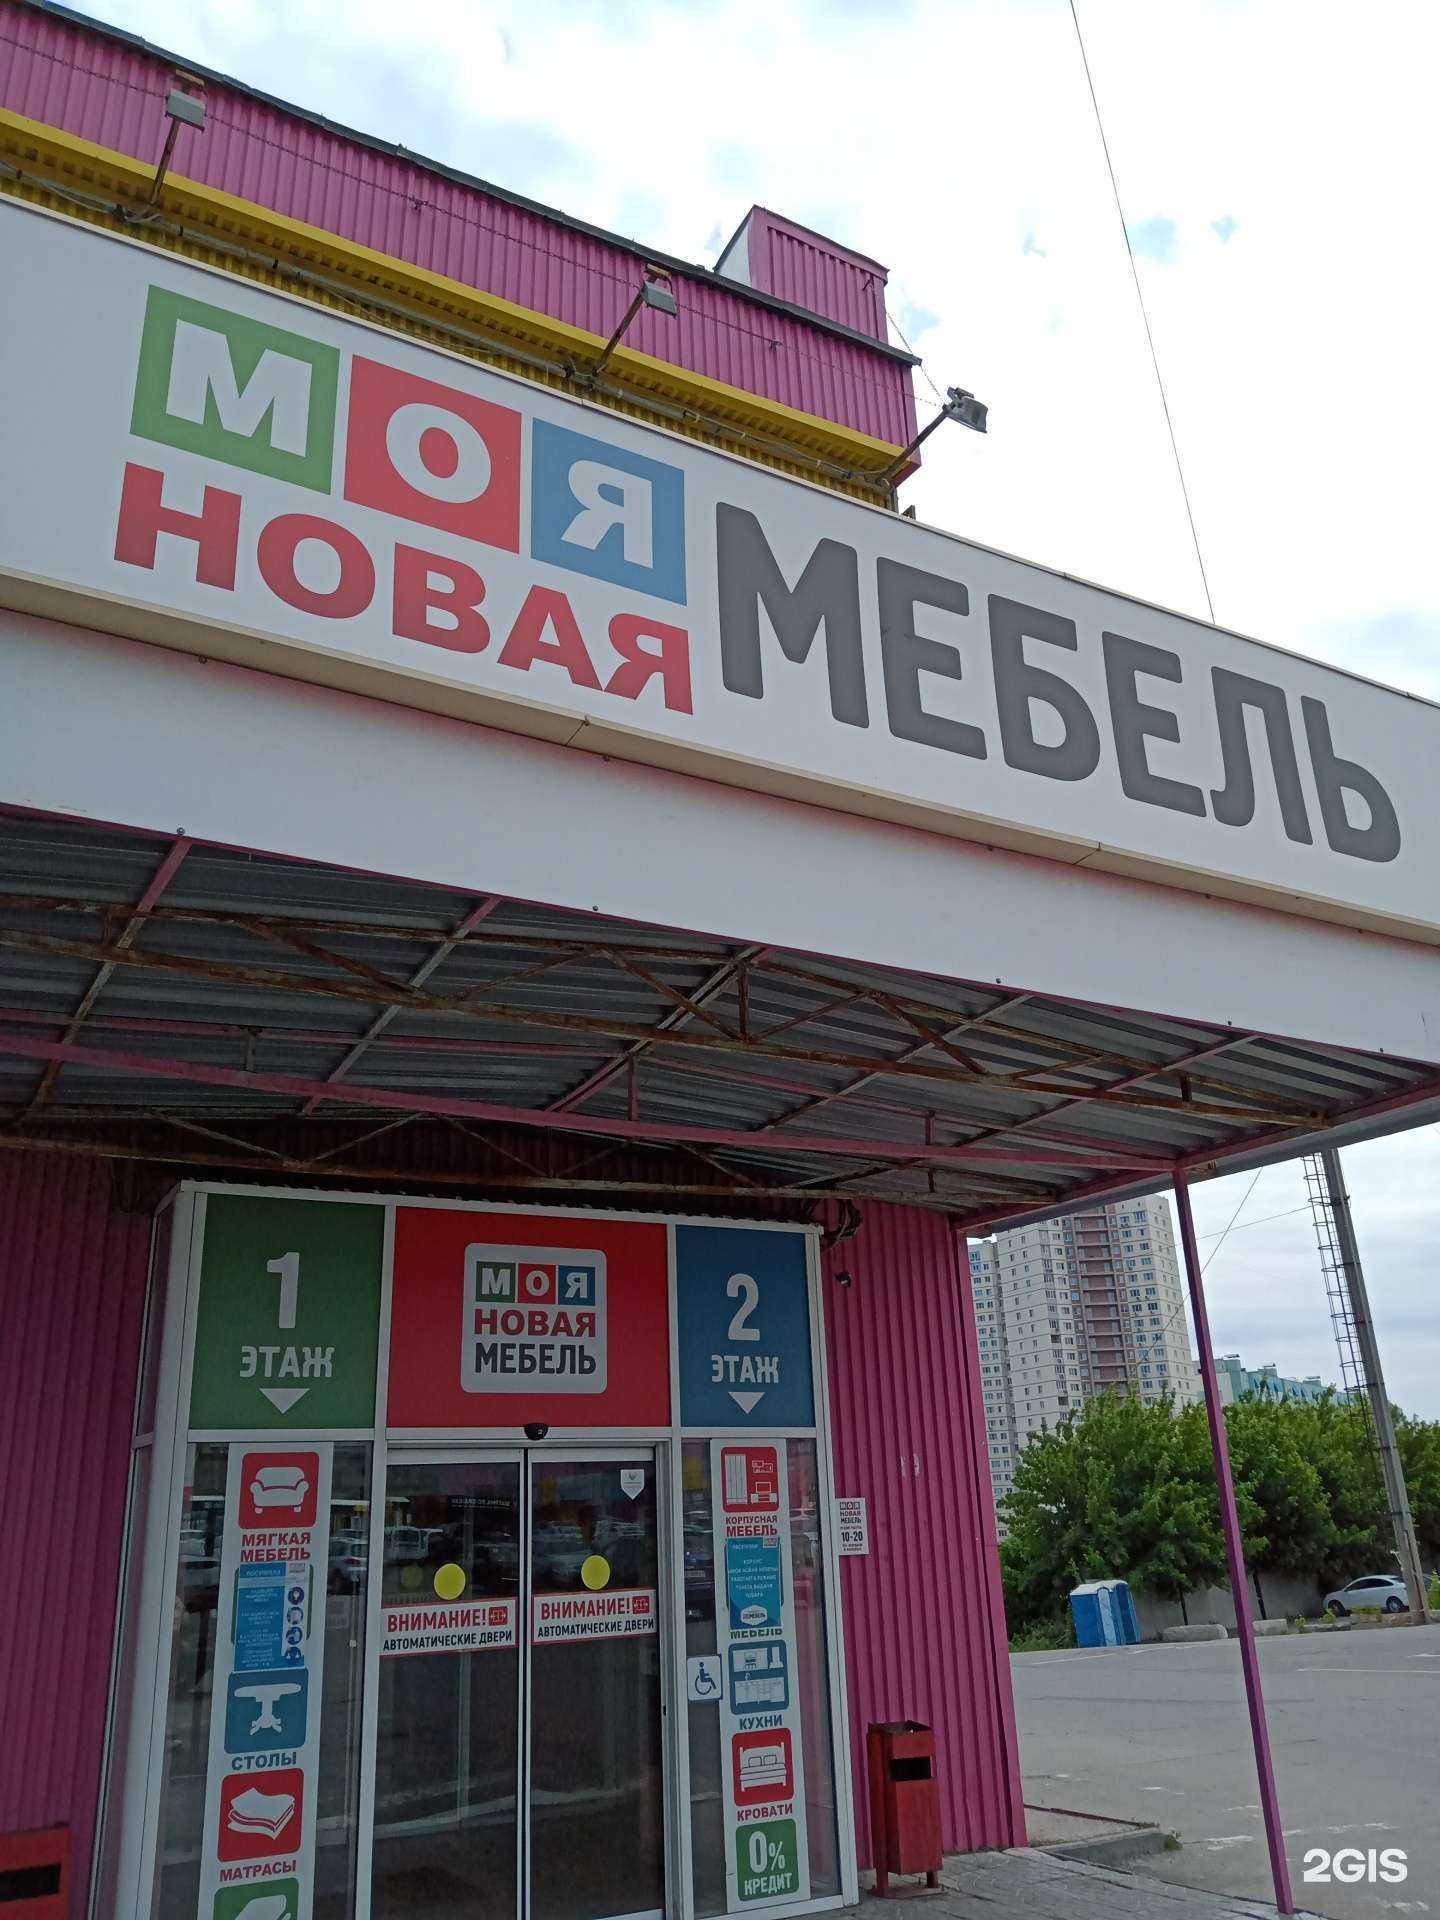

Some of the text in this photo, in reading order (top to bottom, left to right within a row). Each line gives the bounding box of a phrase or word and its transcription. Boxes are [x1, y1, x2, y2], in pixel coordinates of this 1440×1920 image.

[165, 317, 654, 570] МОЯ
[113, 461, 694, 716] НОВАЯ
[715, 501, 1402, 863] МЕБЕЛЬ
[266, 1251, 300, 1329] 1
[480, 1266, 589, 1299] МОЯ
[726, 1272, 761, 1341] 2
[473, 1307, 597, 1338] НОВАЯ
[239, 1345, 336, 1379] ЭТАЖ
[474, 1342, 597, 1375] МЕБЕЛЬ
[710, 1354, 780, 1384] ЭТАЖ
[725, 1514, 778, 1525] КОРПУСНАЯ
[726, 1525, 778, 1537] МЕБЕЛЬ
[241, 1531, 311, 1547] МЯГКАЯ
[841, 1531, 864, 1542] 10-20
[240, 1547, 311, 1562] МЕБЕЛЬ
[387, 1608, 487, 1632] ВНИМАНИЕ!
[541, 1597, 631, 1620] ВНИМАНИЕ!
[383, 1629, 512, 1651] АВТОМАТИЧЕСКИЕ ДВЕРИ
[537, 1618, 655, 1638] АВТОМАТИЧЕСКИЕ ДВЕРИ
[739, 1714, 783, 1730] КУХНИ
[231, 1751, 297, 1771] СТОЛЫ
[737, 1803, 794, 1822] КРОВАТИ
[748, 1830, 786, 1874] 0%
[219, 1860, 297, 1882] МАТРАСЫ
[743, 1872, 793, 1897] КРЕДИТ
